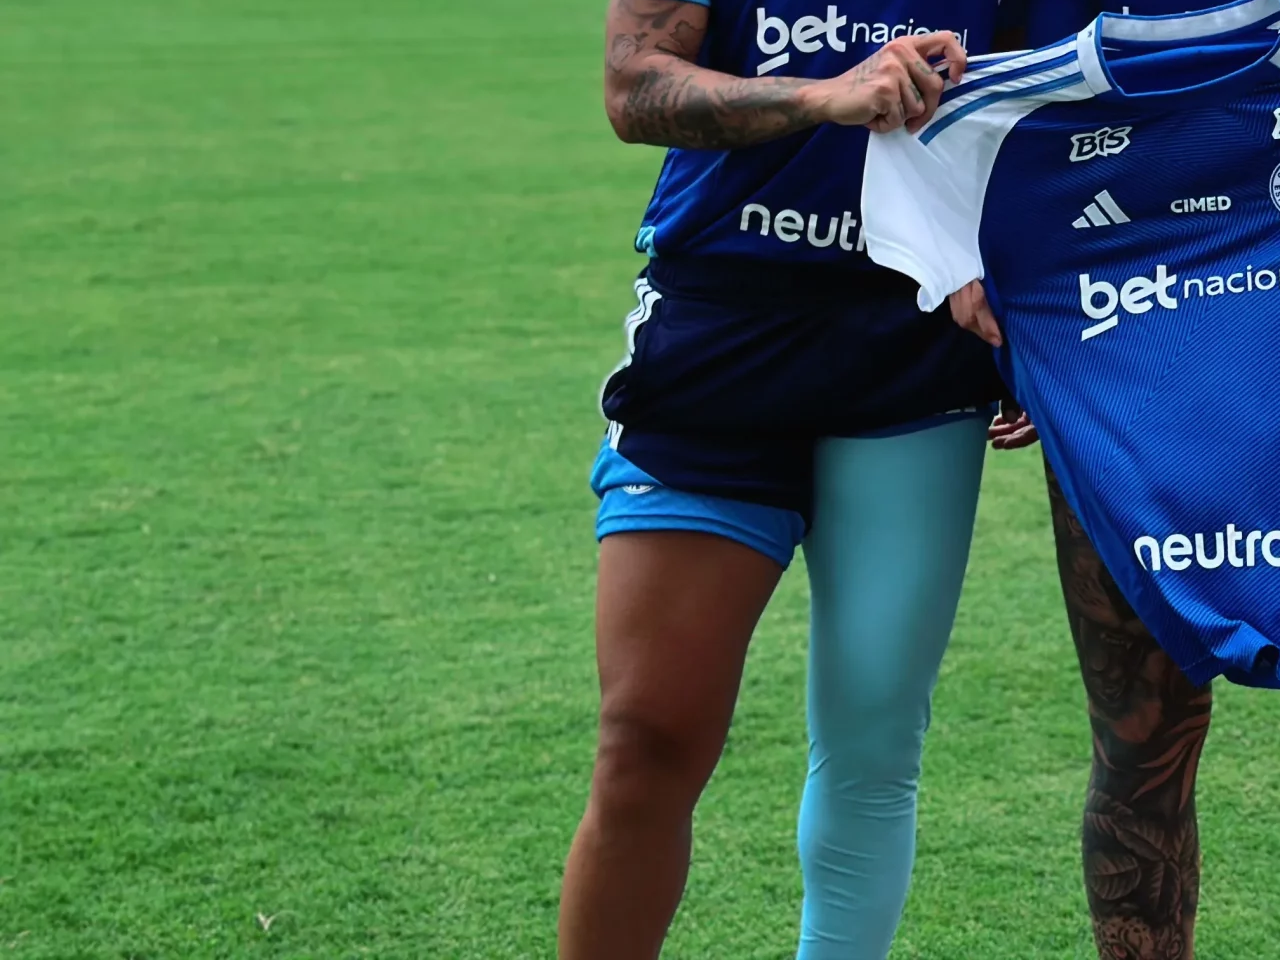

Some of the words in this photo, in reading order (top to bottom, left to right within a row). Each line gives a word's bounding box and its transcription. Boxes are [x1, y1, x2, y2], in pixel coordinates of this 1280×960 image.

[756, 5, 847, 56] bet
[1170, 195, 1232, 213] CIMED
[1079, 264, 1178, 322] bet
